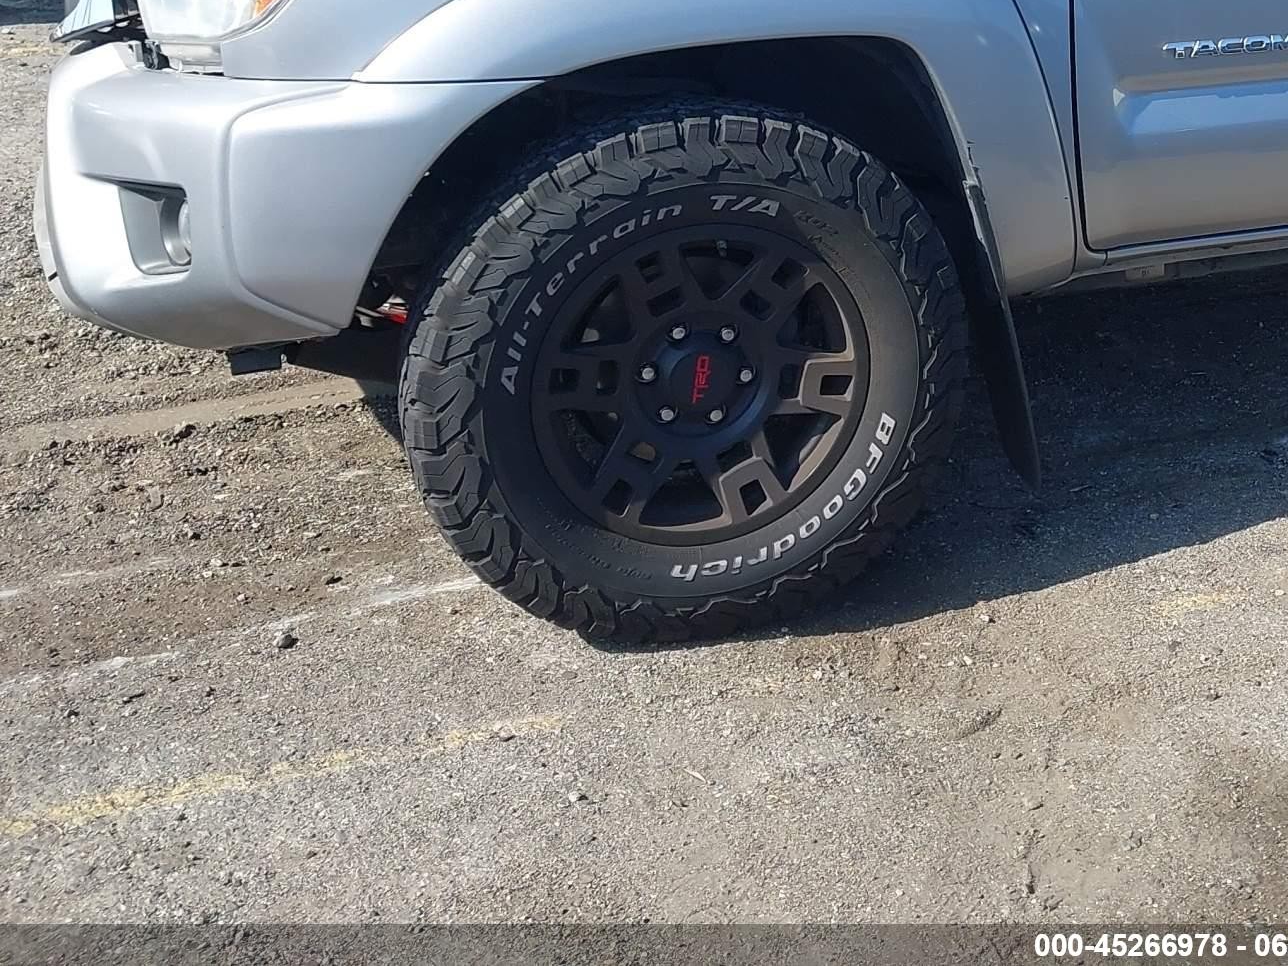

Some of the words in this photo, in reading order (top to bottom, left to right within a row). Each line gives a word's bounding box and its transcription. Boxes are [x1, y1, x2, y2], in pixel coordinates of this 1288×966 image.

[500, 203, 683, 396] All-Terrain
[709, 194, 781, 217] T/A
[691, 354, 712, 405] TRD
[670, 411, 897, 583] BFGoodrich
